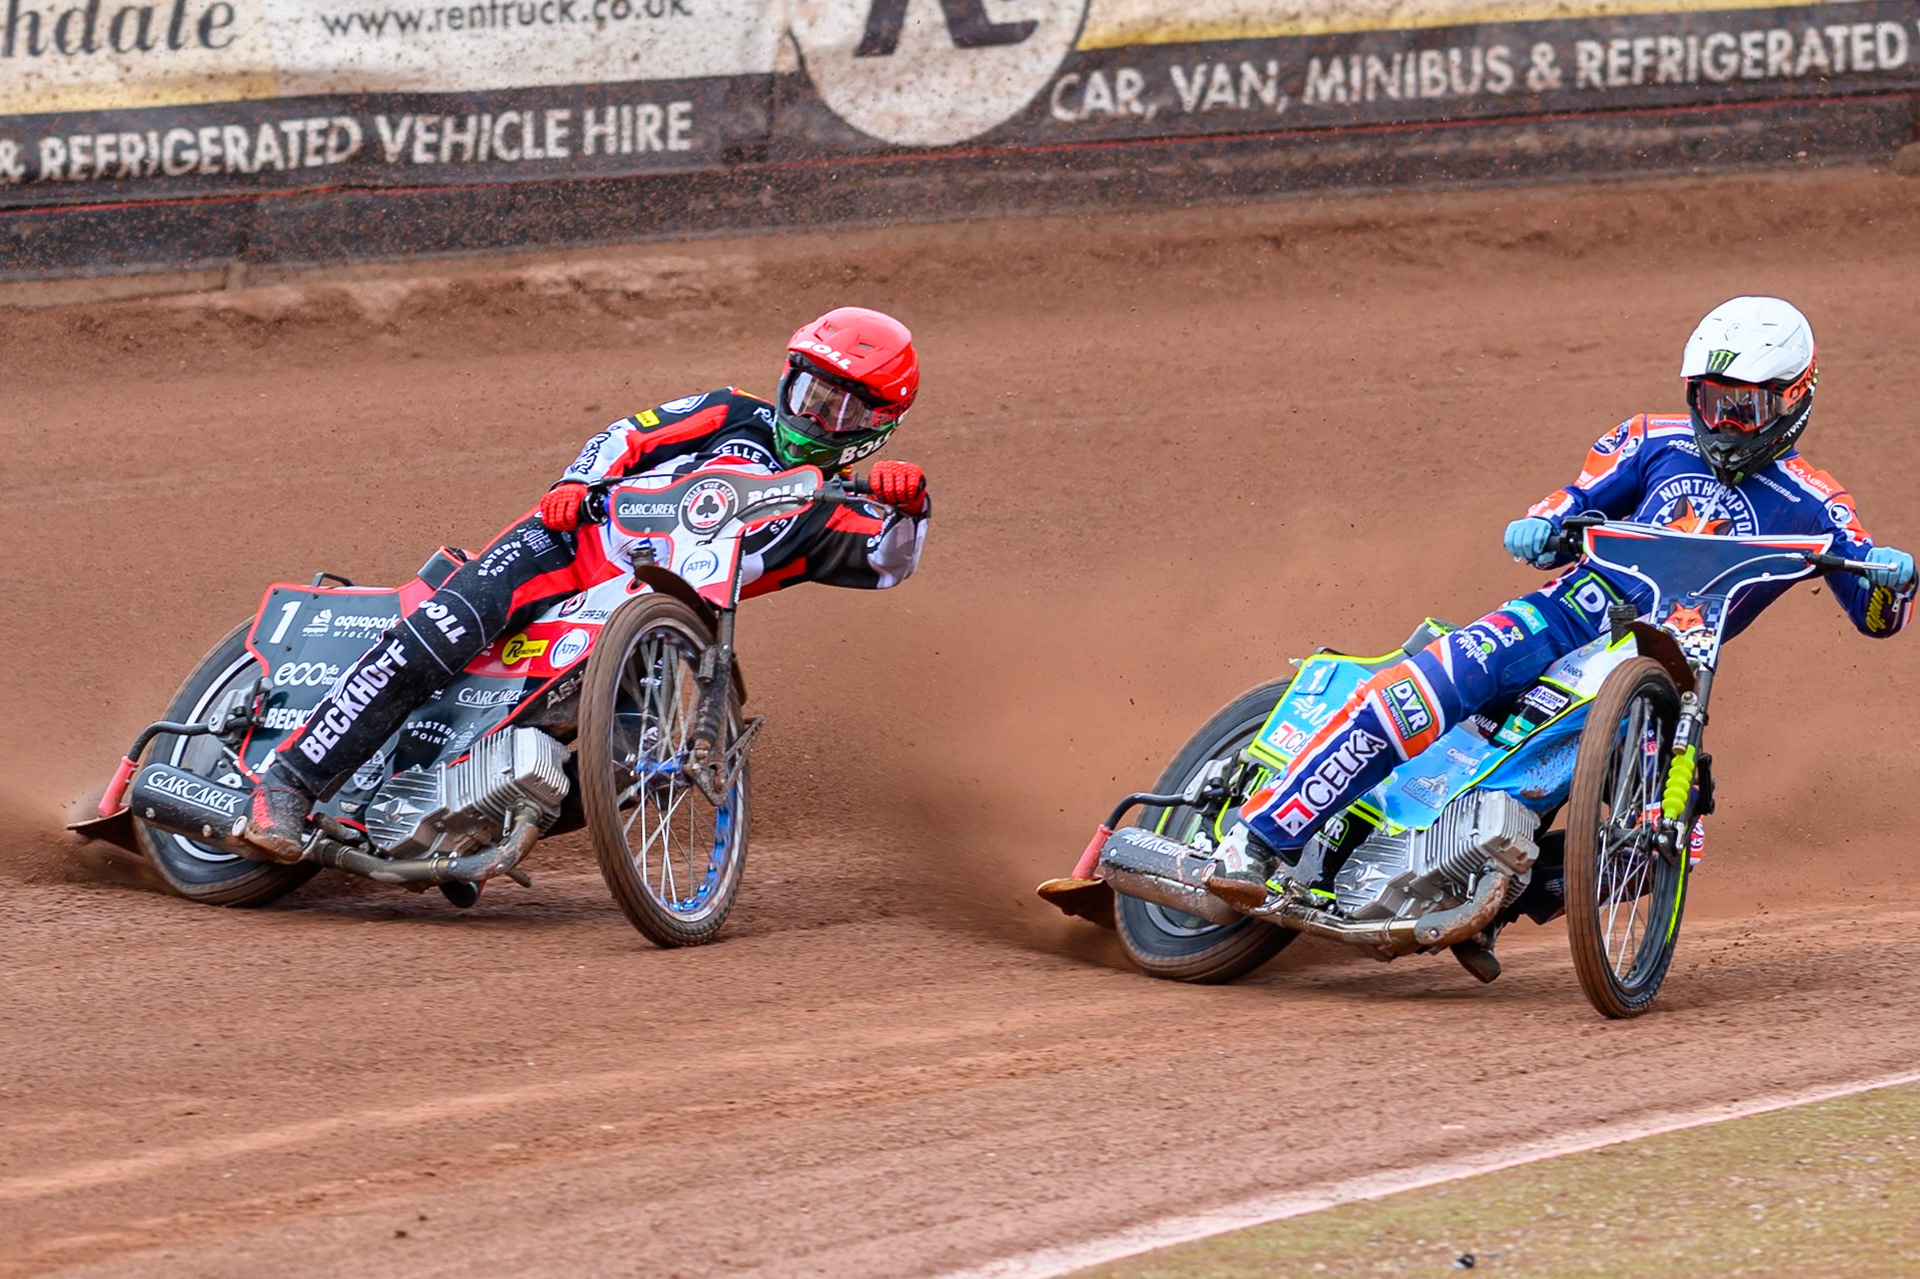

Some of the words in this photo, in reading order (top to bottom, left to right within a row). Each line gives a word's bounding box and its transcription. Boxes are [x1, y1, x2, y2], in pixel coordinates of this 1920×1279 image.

[1050, 67, 1158, 121] CAR,
[1169, 59, 1288, 114] VAN,
[1303, 45, 1514, 104] MINIBUS
[1527, 42, 1562, 90] &
[1575, 22, 1908, 88] REFRIGERATED
[38, 114, 363, 182] REFRIGERATED
[374, 107, 572, 164] VEHICLE
[582, 100, 693, 156] HIRE
[796, 340, 852, 370] BOLL
[618, 503, 678, 515] GARCAREK
[269, 601, 302, 644] 1
[334, 613, 400, 631] aquapark
[1307, 666, 1327, 694] 1
[264, 708, 311, 730] BECK
[299, 639, 408, 764] BECKHOFF
[1392, 681, 1428, 731] DVR
[407, 721, 457, 740] EASTERN
[411, 729, 449, 745] POINT
[1302, 729, 1388, 809] CELKA
[147, 771, 244, 813] GARCAREK
